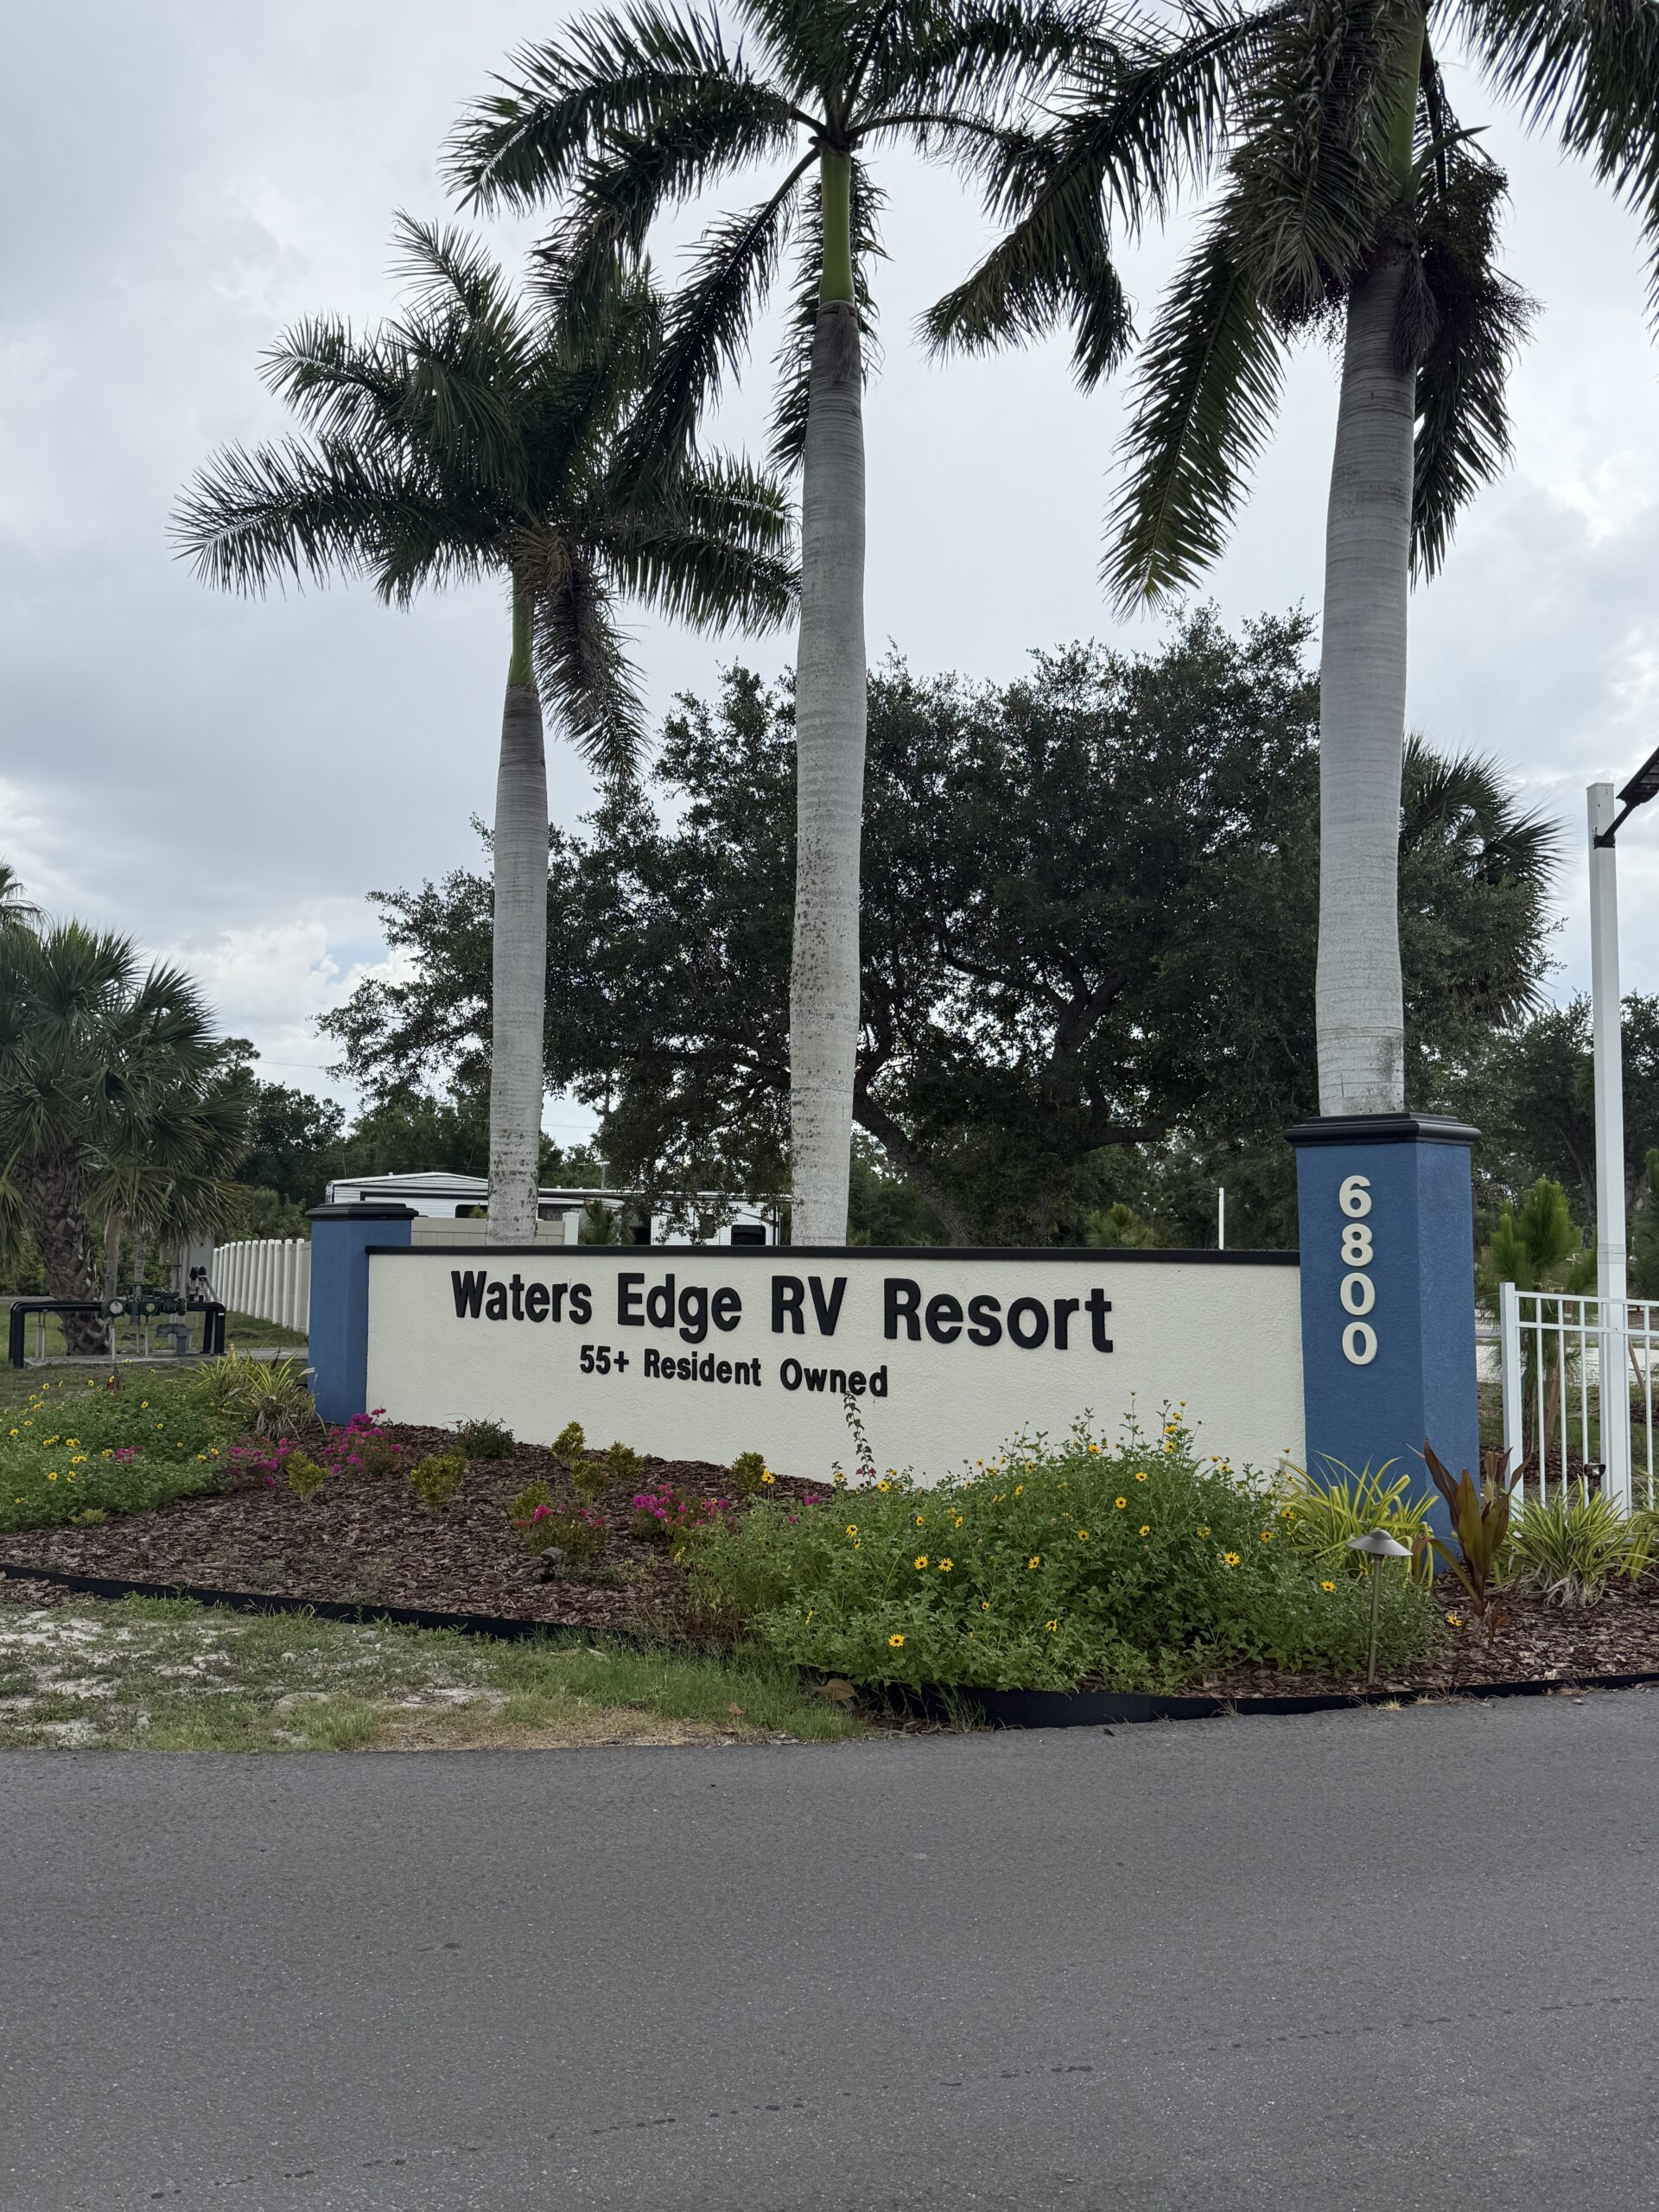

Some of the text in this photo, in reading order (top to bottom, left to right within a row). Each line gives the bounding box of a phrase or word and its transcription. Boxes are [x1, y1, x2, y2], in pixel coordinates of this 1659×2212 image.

[450, 1270, 1114, 1354] Waters Edge RV Resort
[1338, 1175, 1377, 1365] 6800
[580, 1344, 888, 1398] 55+ Resident Owned
